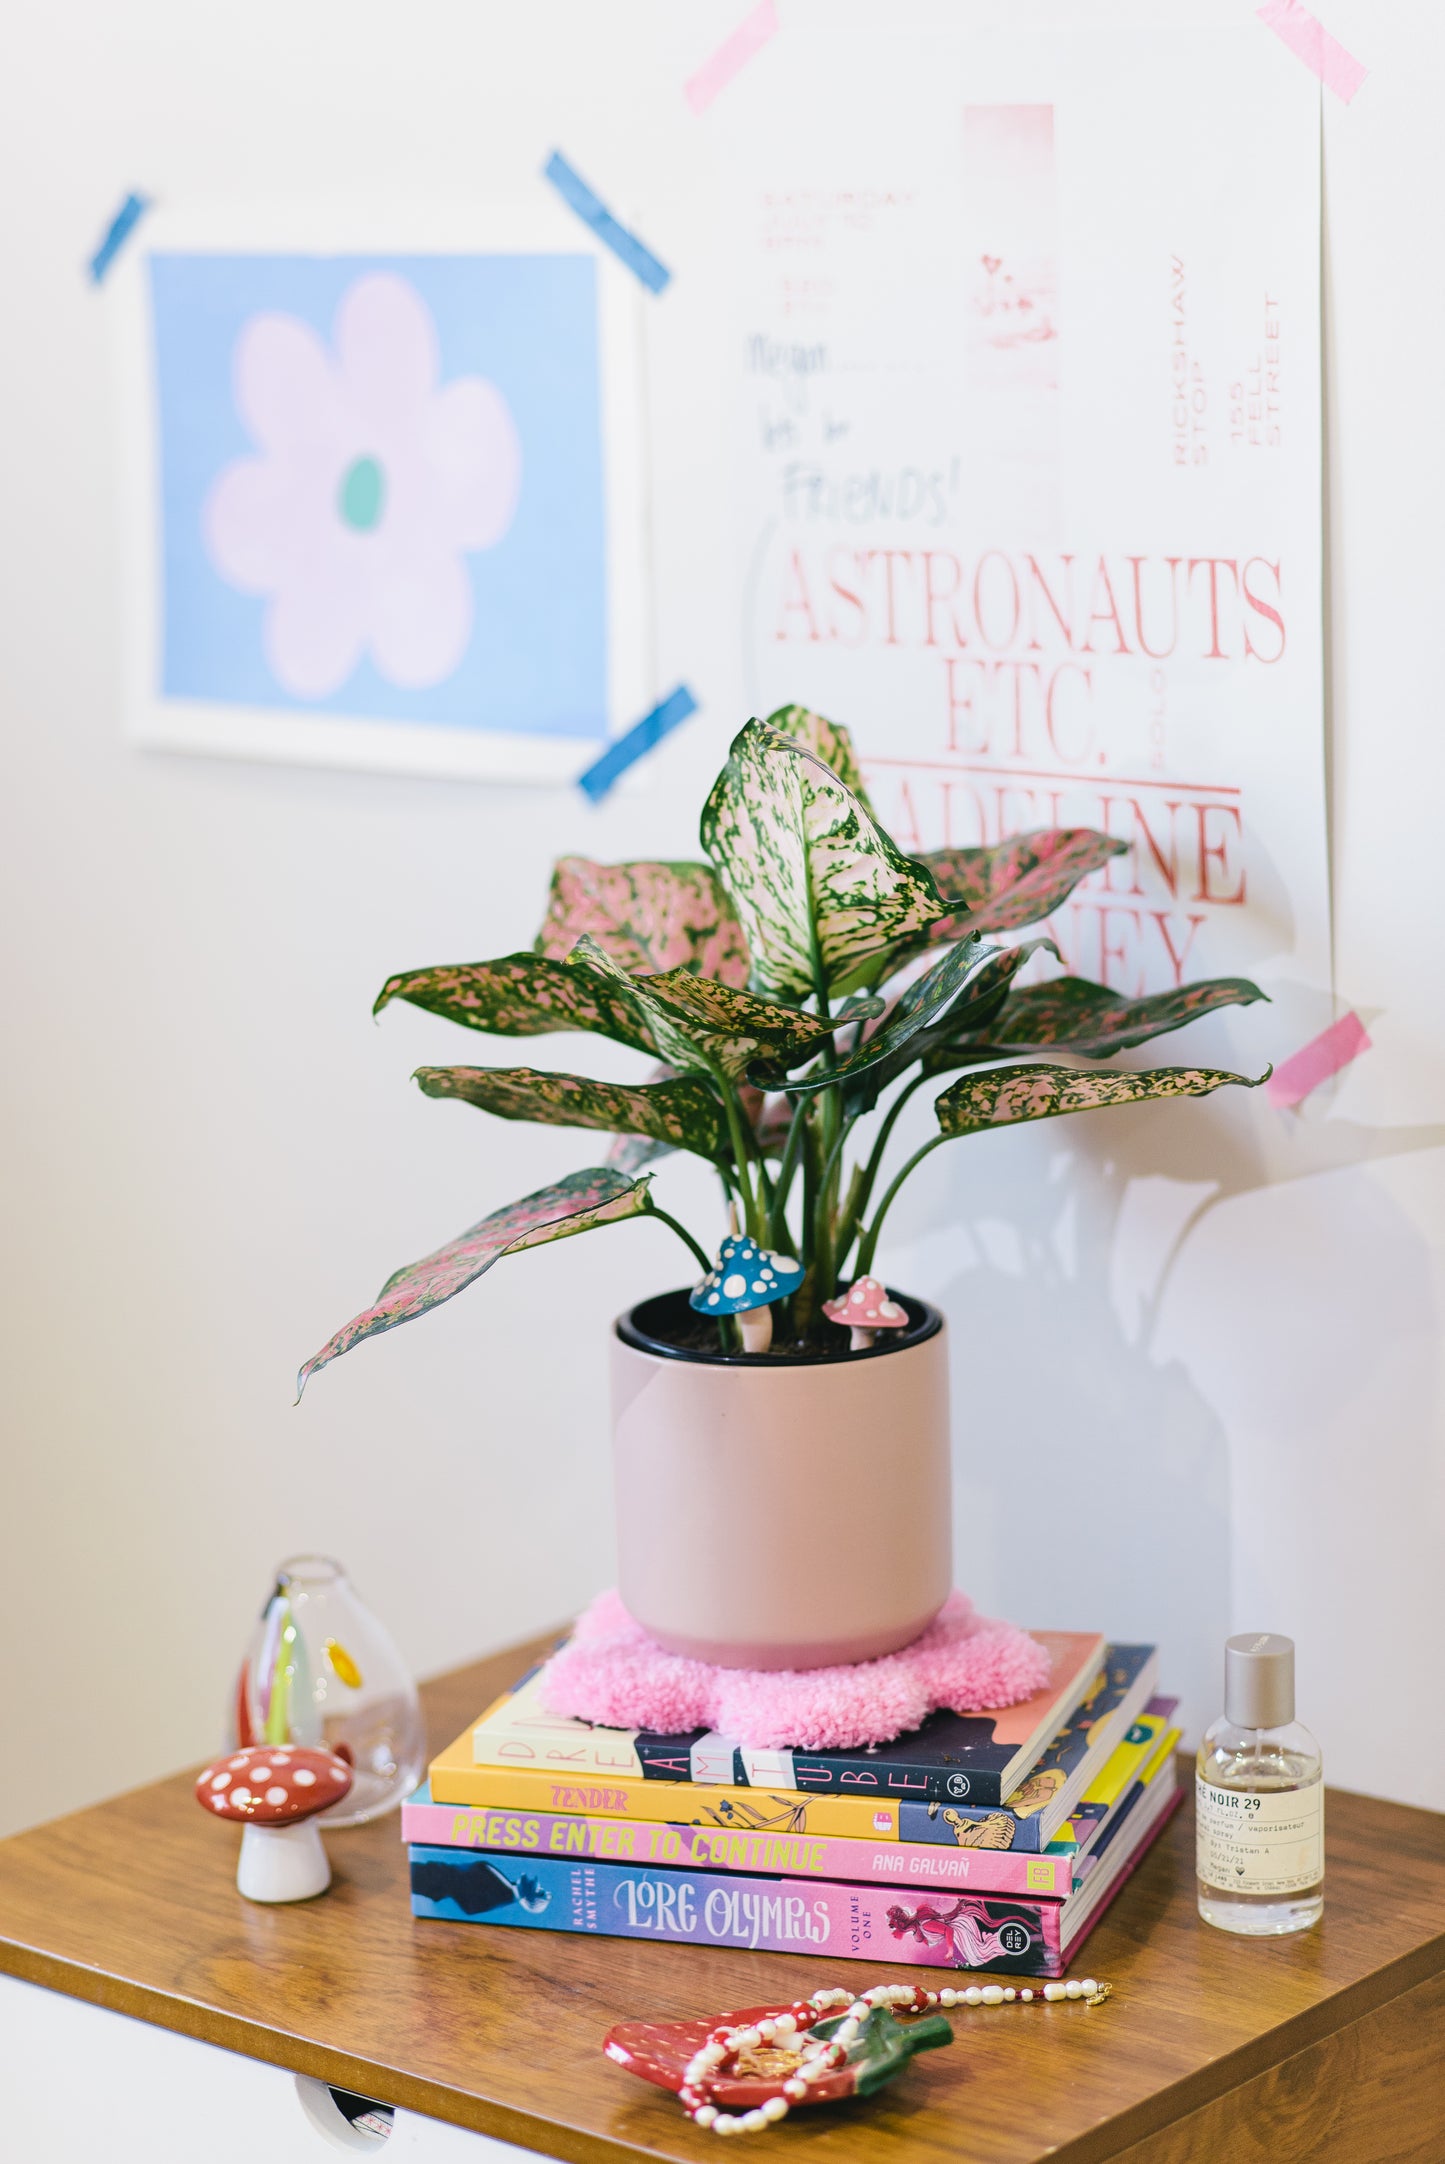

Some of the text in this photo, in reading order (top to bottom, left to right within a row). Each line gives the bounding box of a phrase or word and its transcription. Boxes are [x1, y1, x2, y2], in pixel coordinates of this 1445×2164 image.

[1171, 254, 1189, 465] RICKSHAW
[1263, 290, 1281, 447] STREET
[1190, 361, 1209, 465] STOP
[1229, 381, 1245, 445] 155
[1247, 353, 1263, 446] FELL
[774, 547, 1287, 664] ASTRONAUTS
[944, 658, 1106, 766] ETC.
[551, 1785, 629, 1812] TENDER
[1209, 1790, 1239, 1809] NOIR
[1244, 1798, 1261, 1811] 29
[1248, 1822, 1305, 1833] vaporisateur
[451, 1814, 971, 1879] PRESS ENTER TO CONTINUE ANA GALVAÑ
[1033, 1868, 1050, 1884] FB
[571, 1868, 584, 1927] RACHEL
[584, 1867, 598, 1930] SMYTHE
[613, 1872, 832, 1950] LORE OLYMPUS
[851, 1894, 860, 1952] VOLUME
[862, 1909, 872, 1940] ONE
[1005, 1929, 1014, 1949] DEL
[1014, 1929, 1023, 1950] REY
